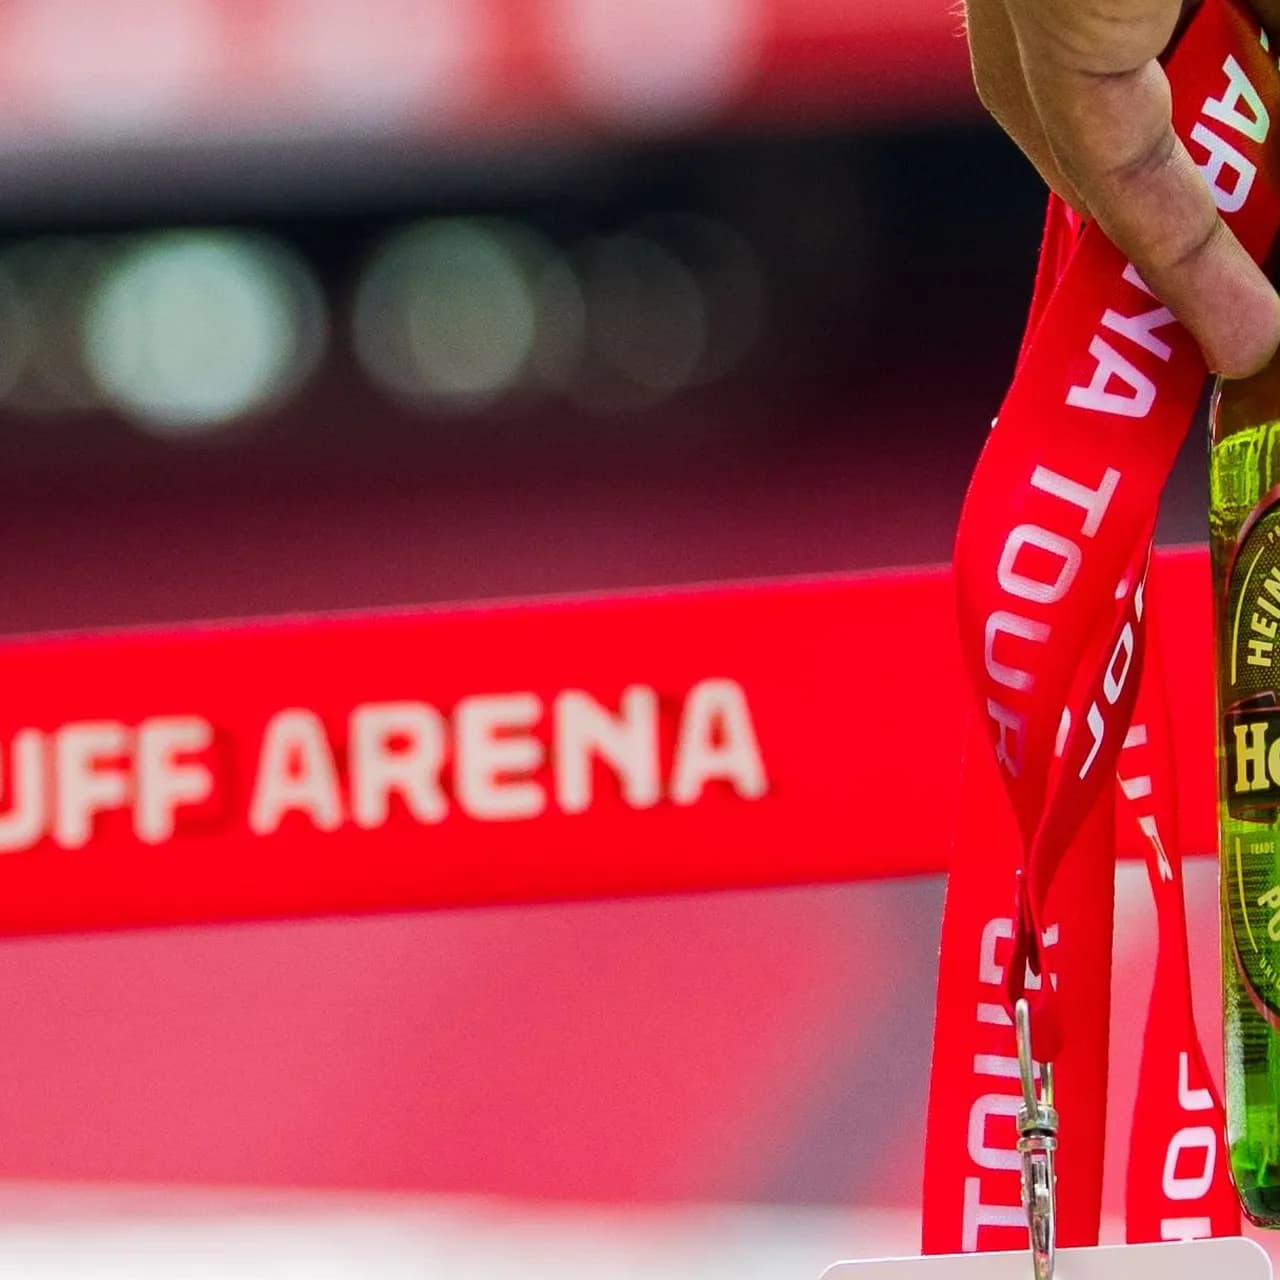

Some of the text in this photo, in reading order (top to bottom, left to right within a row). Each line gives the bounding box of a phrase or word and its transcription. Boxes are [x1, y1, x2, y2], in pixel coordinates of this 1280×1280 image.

[983, 463, 1122, 778] TOUR
[249, 676, 769, 836] ARENA
[1250, 841, 1275, 855] TRADE
